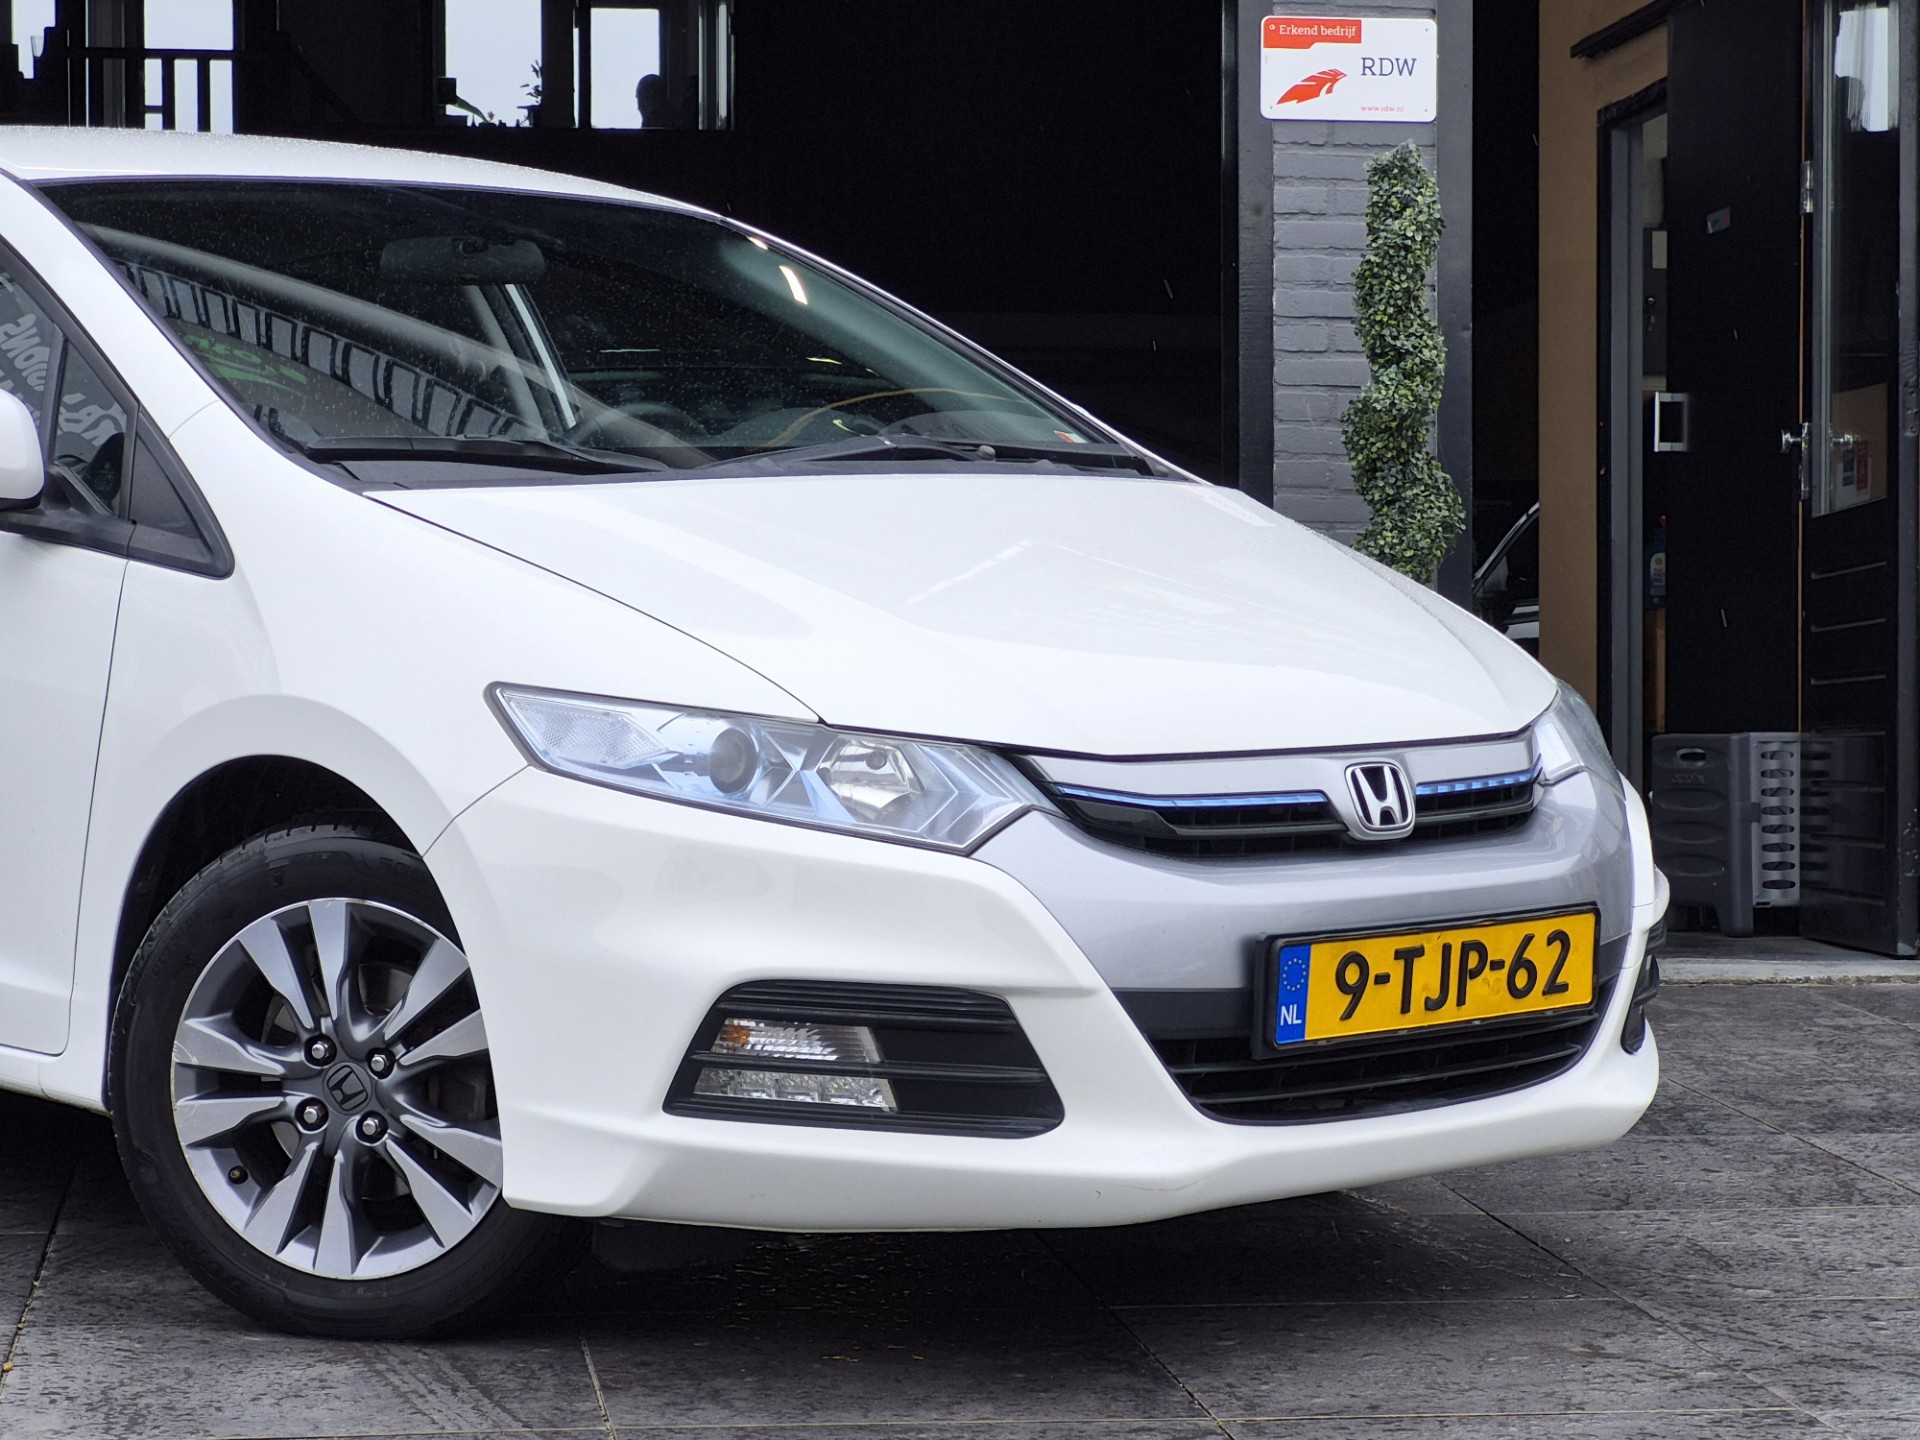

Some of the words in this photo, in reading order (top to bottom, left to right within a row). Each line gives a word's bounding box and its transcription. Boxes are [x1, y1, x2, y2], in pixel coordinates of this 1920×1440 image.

[1279, 24, 1318, 36] Erkend
[1320, 25, 1357, 39] bedrijf
[1361, 57, 1417, 77] RDW
[1335, 928, 1571, 1022] 9-TJP-62
[1280, 1003, 1302, 1027] NL
